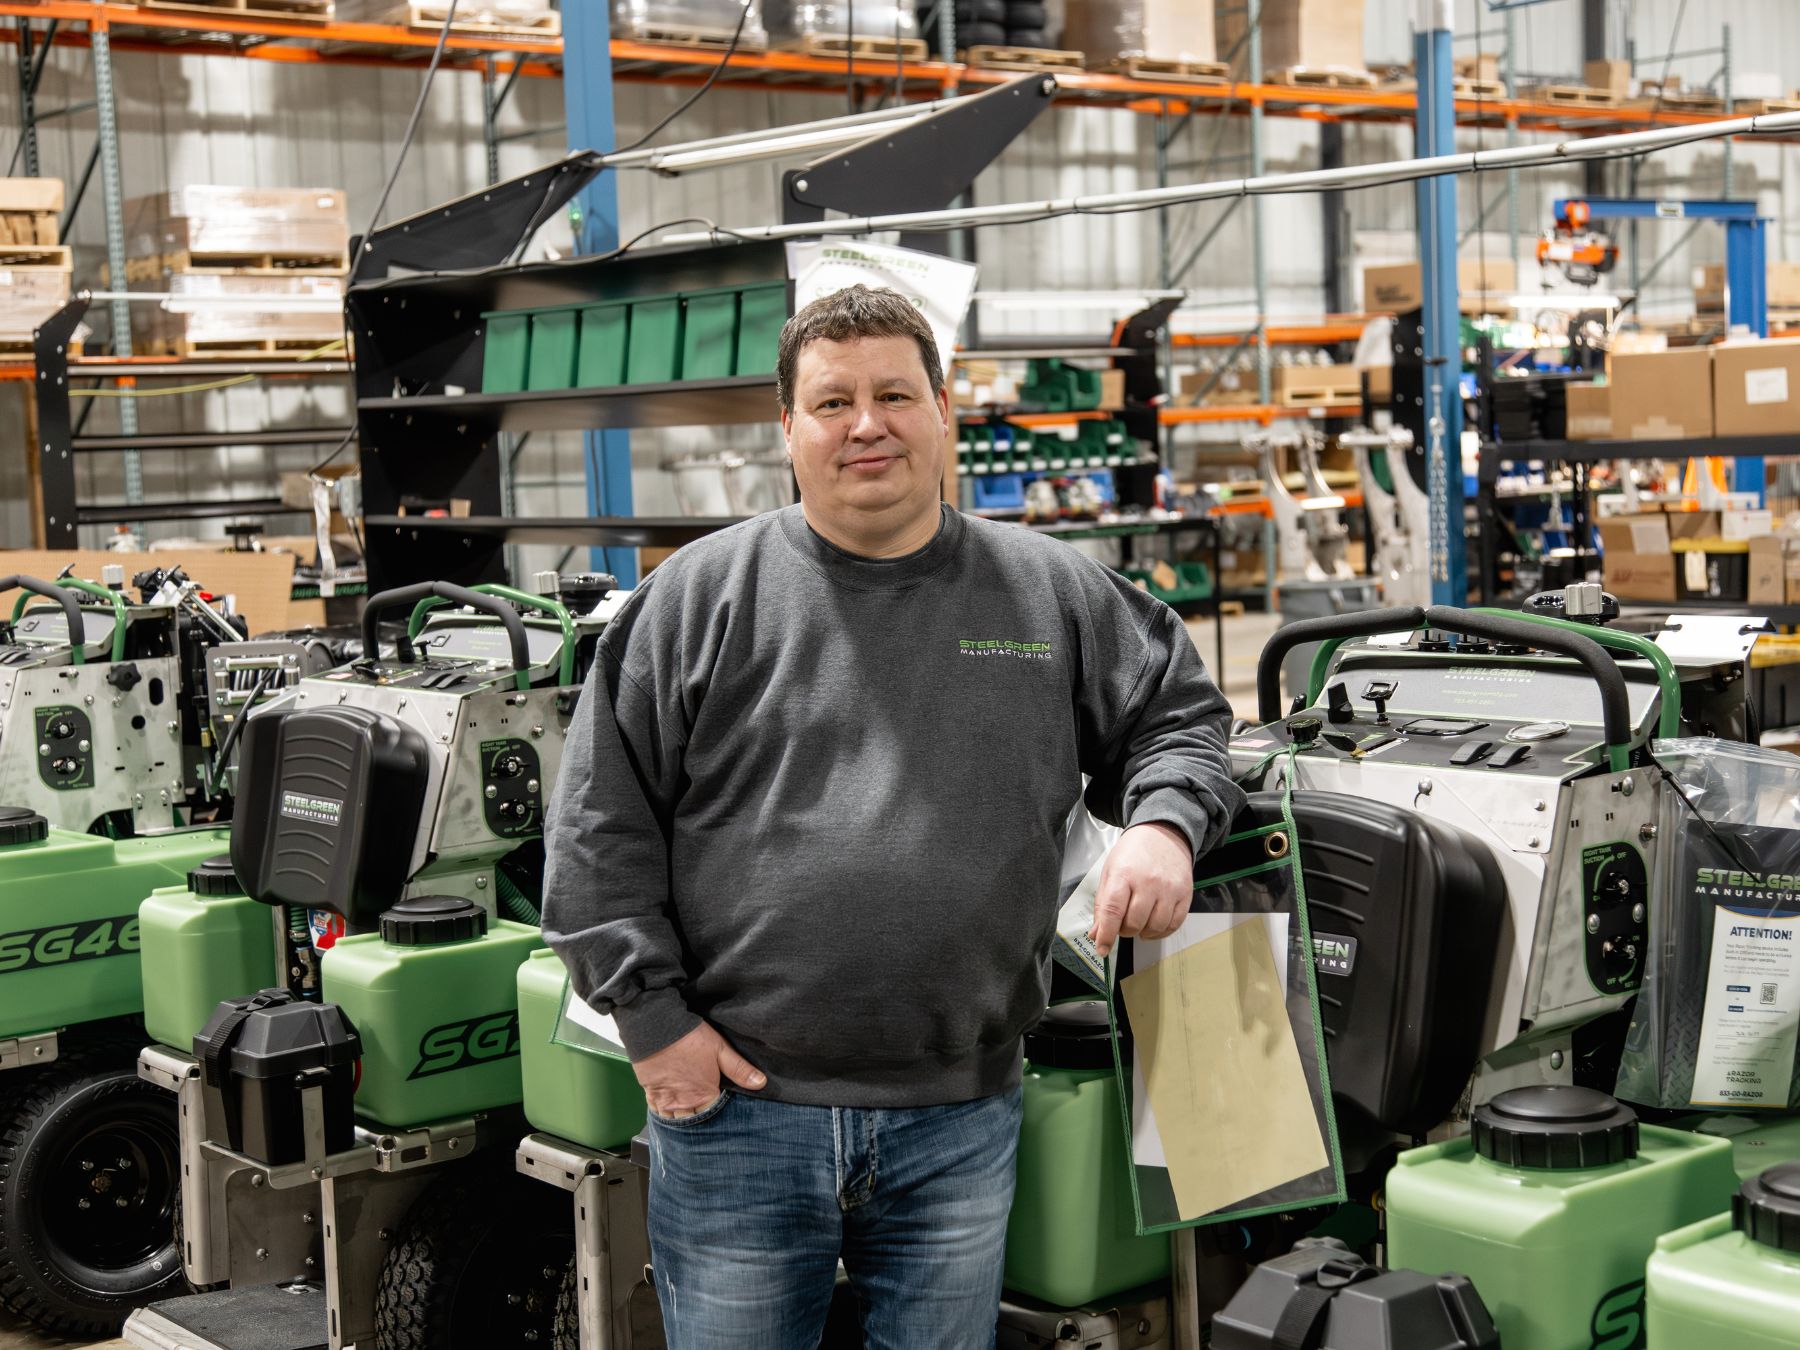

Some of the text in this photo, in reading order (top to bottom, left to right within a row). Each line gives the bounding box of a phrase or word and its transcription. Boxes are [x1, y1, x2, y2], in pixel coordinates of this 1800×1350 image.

[959, 639, 1051, 652] STEELGREEN
[960, 648, 1053, 659] MANUFACTURING
[1447, 666, 1537, 678] STEELGREEN
[284, 794, 340, 815] STEELGREEN
[283, 806, 338, 822] MANUFACTURING
[1617, 852, 1627, 860] OFF
[1730, 926, 1793, 941] ATTENTION!
[1606, 977, 1617, 985] OFF
[1726, 1076, 1762, 1084] TRACKING
[1719, 1090, 1764, 1098] 833-GO-RAZOR
